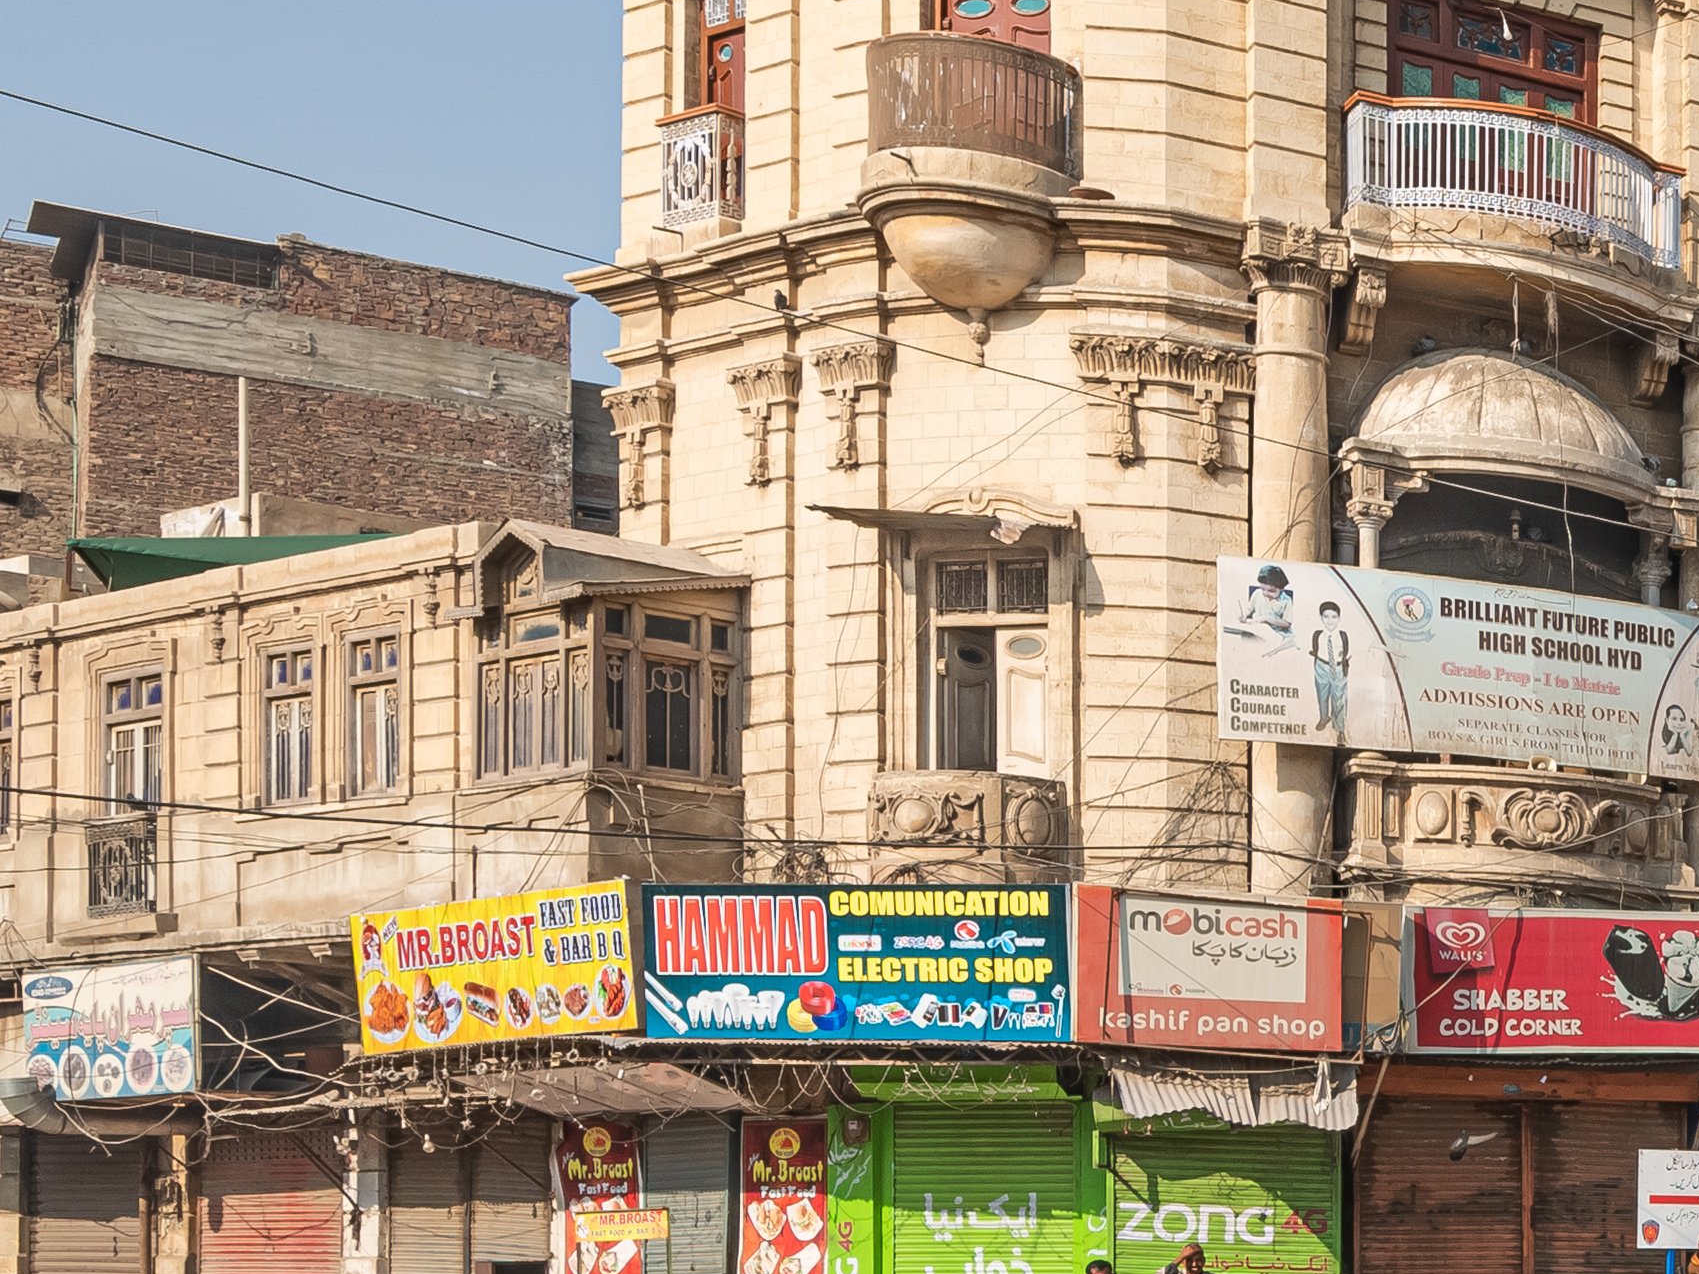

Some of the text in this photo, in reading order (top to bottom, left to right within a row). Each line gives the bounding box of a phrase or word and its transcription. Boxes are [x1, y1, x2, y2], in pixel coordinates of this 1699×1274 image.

[1440, 597, 1675, 648] BRILLIANT FUTURE PUBLIC
[1479, 630, 1642, 671] HIGH SCHOOL HYD
[1230, 679, 1299, 699] CHARACTER
[1440, 661, 1491, 679] Grade
[1494, 666, 1531, 688] Prep
[1554, 677, 1568, 689] to
[1573, 677, 1621, 696] Matric
[1230, 697, 1286, 716] COURAGE
[1419, 688, 1641, 726] ADMISSIONS ARE OPEN
[1230, 715, 1307, 735] COMPETENCE
[1457, 718, 1606, 743] SEPARATE CLASSES FOR
[1428, 730, 1464, 742] BOYS
[1466, 733, 1476, 743] &
[1480, 735, 1519, 747] GIRLS
[1522, 739, 1559, 752] FROM
[539, 894, 622, 929] FAST FOOD
[830, 891, 1048, 916] COMUNICATION
[654, 896, 828, 975] HAMMAD
[1130, 907, 1297, 939] mobicash
[543, 929, 625, 965] & BAR B Q
[1229, 942, 1248, 958] کا
[1245, 944, 1297, 967] زبان
[838, 958, 1052, 983] ELECTRIC SHOP
[1453, 988, 1569, 1011] SHABBER
[1099, 1006, 1325, 1039] kashif pan shop
[1440, 1018, 1583, 1037] COLD CORNER
[578, 1182, 628, 1195] Fast Food
[760, 1185, 816, 1199] Fast Food
[923, 1192, 1037, 1241] ایک نیا
[1281, 1209, 1328, 1235] 4G
[836, 1221, 853, 1253] 4G
[1246, 1256, 1328, 1274] ایک نیا
